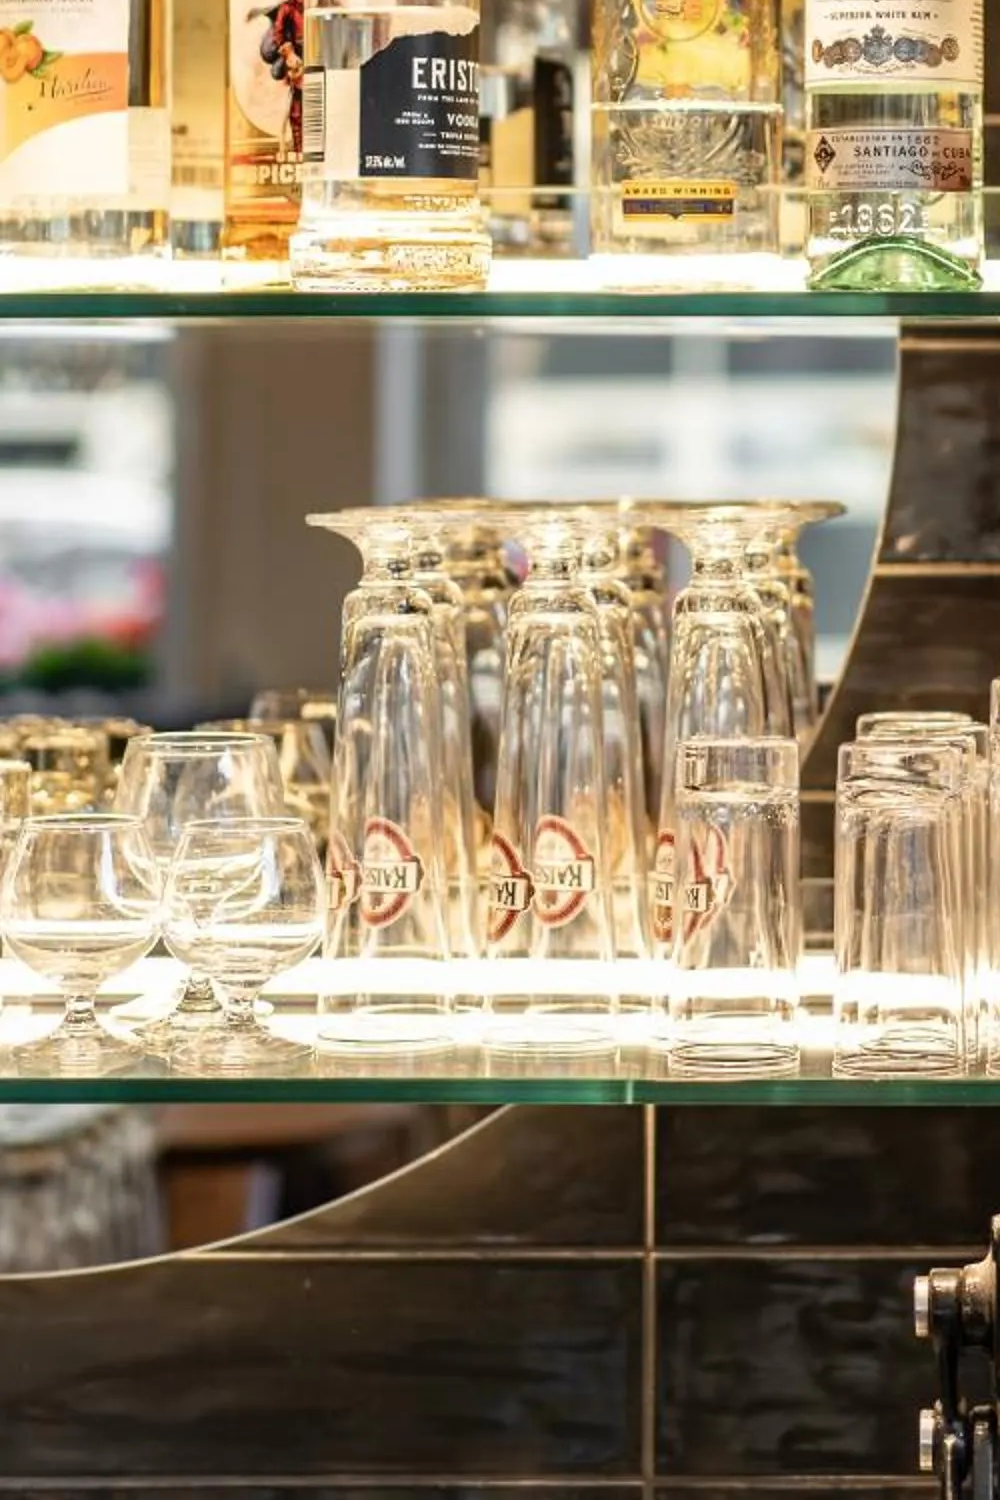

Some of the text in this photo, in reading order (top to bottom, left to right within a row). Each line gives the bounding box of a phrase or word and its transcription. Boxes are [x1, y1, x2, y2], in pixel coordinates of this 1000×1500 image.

[853, 145, 929, 158] SANTIAGO
[624, 186, 731, 196] AWARD WINNING
